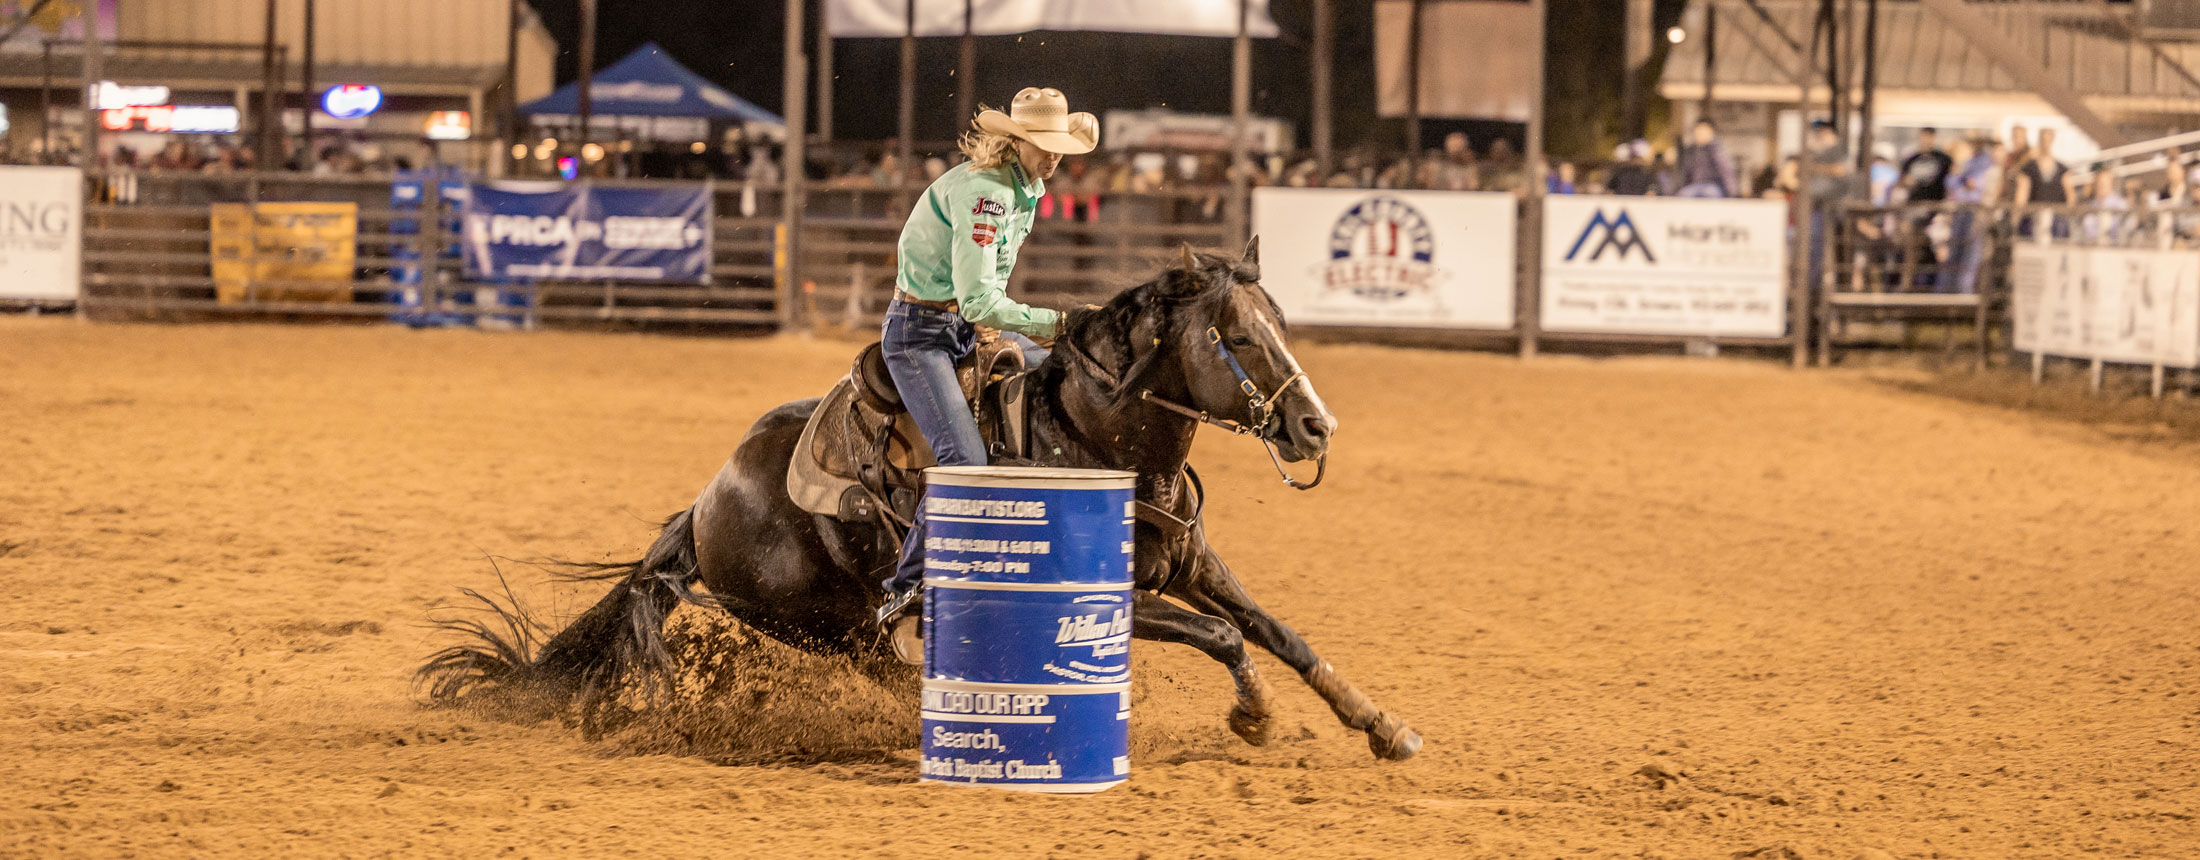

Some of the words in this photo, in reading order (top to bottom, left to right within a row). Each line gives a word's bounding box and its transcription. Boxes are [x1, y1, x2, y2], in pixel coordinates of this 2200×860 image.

[972, 196, 1006, 216] Justin
[1666, 220, 1751, 244] Martin
[1005, 562, 1030, 574] PM
[975, 693, 1011, 715] OUR
[1011, 694, 1050, 715] APP
[932, 725, 1006, 753] Search,
[1004, 758, 1063, 781] Church
